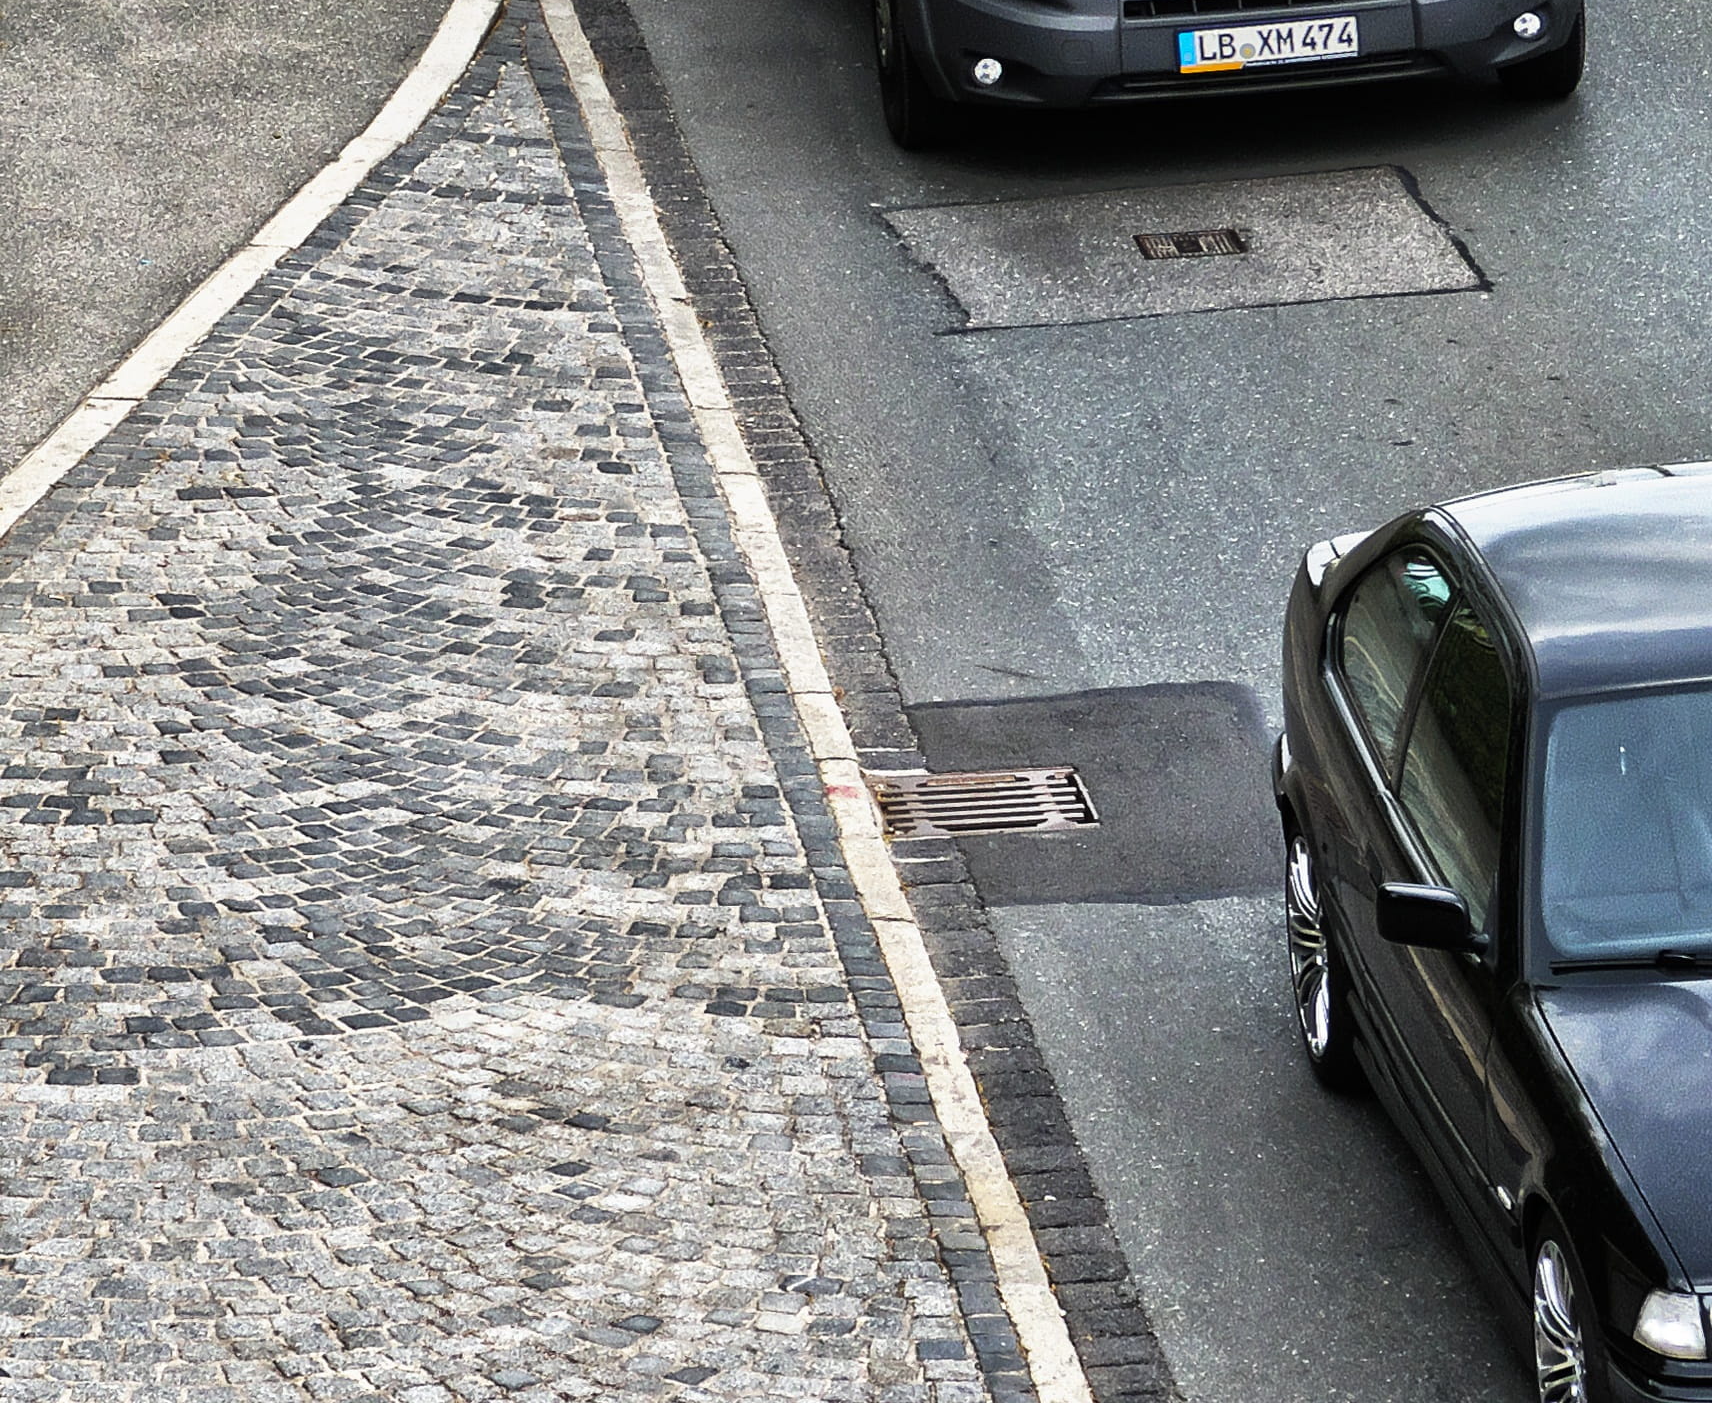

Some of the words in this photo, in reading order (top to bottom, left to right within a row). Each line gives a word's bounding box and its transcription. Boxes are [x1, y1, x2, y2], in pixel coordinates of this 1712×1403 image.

[1199, 33, 1236, 62] LB
[1257, 27, 1295, 57] XM
[1302, 21, 1353, 51] 474
